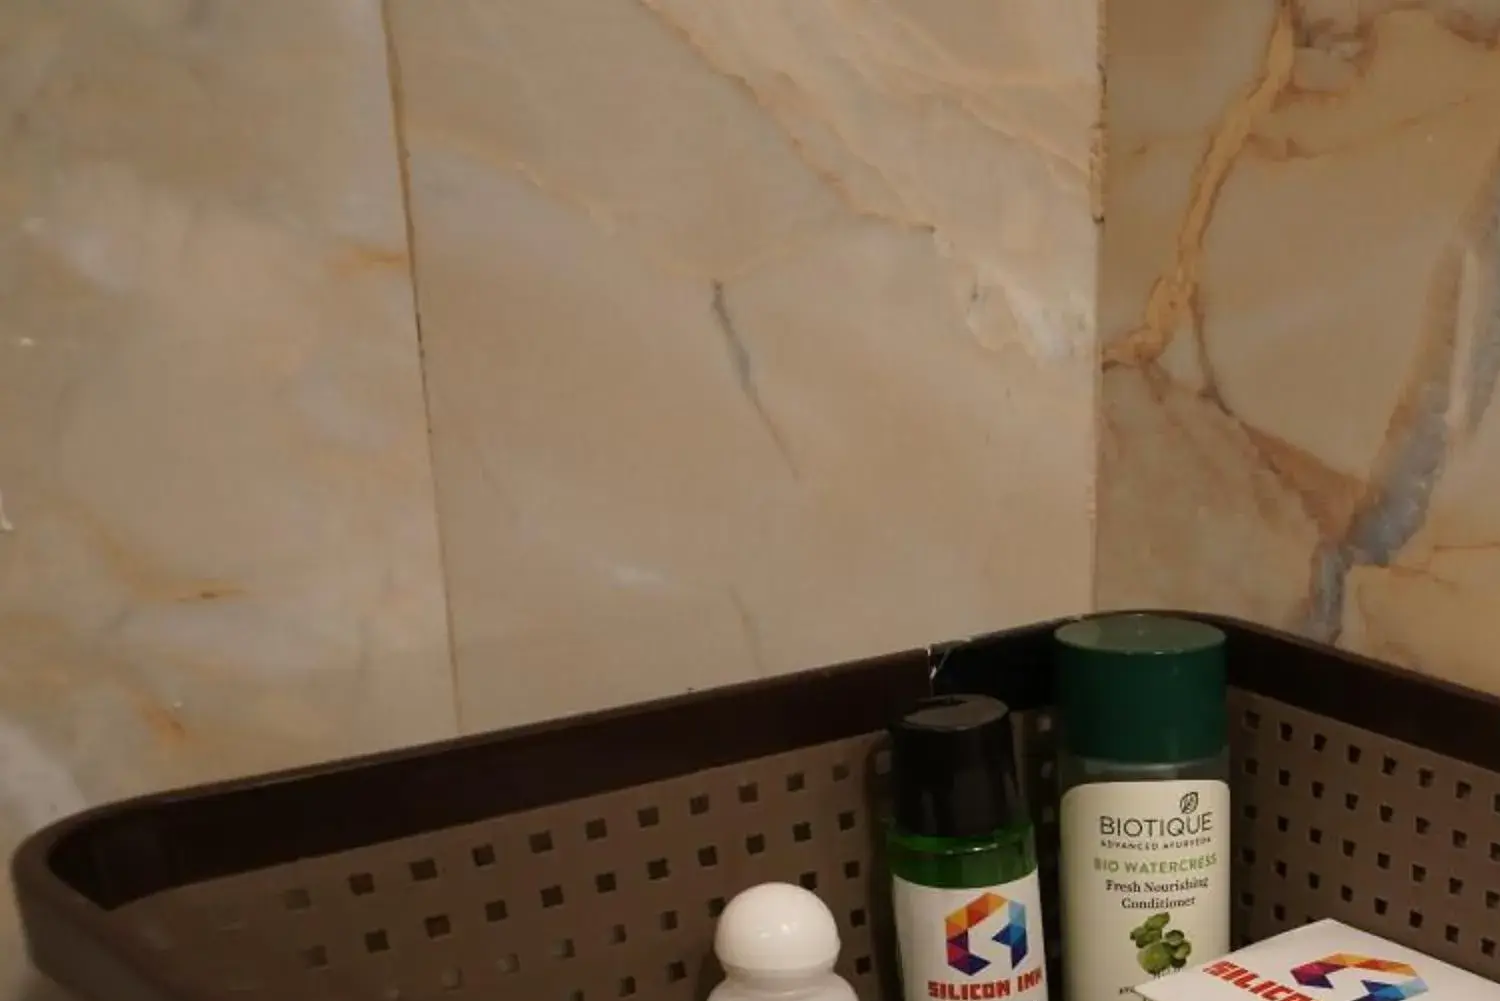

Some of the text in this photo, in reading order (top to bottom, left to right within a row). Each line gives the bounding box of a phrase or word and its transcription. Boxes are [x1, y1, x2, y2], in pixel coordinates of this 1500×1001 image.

[1100, 811, 1213, 837] BIOTIQUE
[1093, 852, 1217, 873] BIO WATERCRESS
[1105, 877, 1209, 893] Fresh Nourishing
[1121, 896, 1196, 909] Conditioner
[927, 980, 1011, 1001] SILICON
